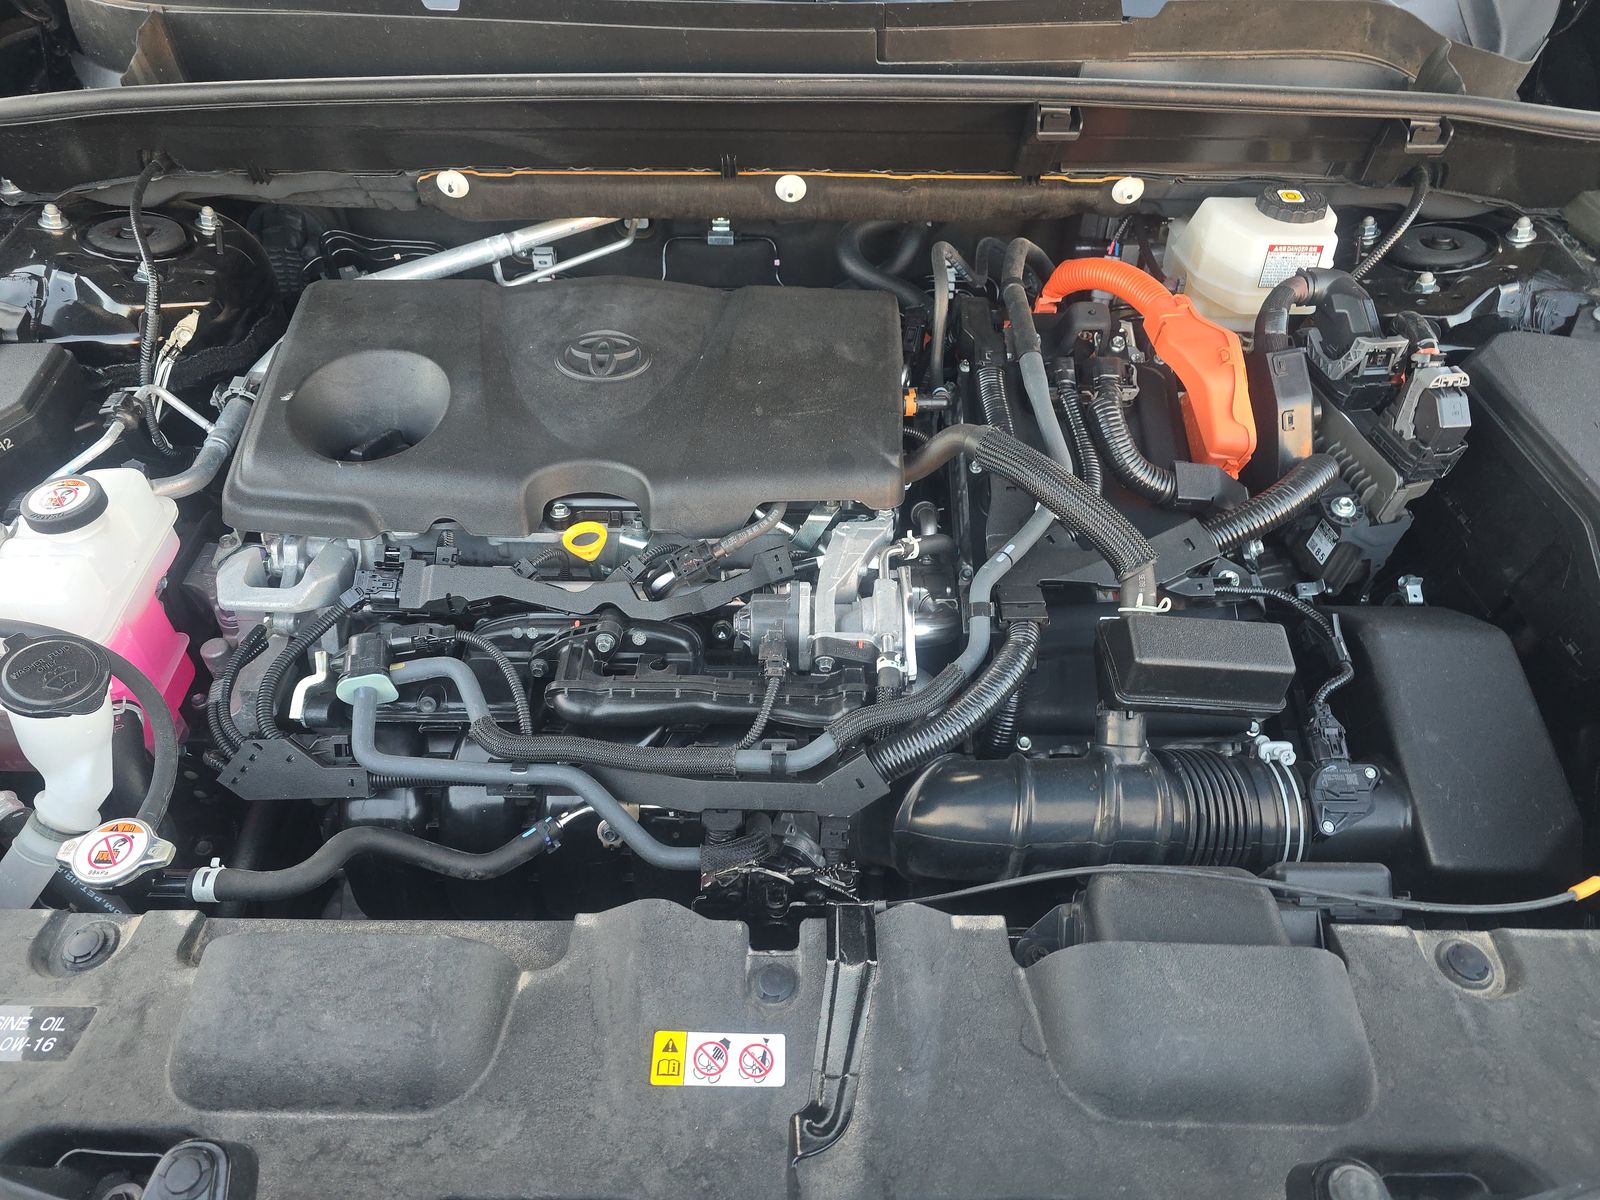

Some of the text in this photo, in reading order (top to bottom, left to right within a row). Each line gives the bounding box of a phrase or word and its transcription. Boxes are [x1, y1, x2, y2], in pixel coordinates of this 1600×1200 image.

[1286, 245, 1310, 253] DANGER
[10, 645, 71, 680] WASHER FLUID
[36, 659, 57, 673] ONLY
[39, 1016, 66, 1032] OIL
[0, 1036, 58, 1053] 0W-16
